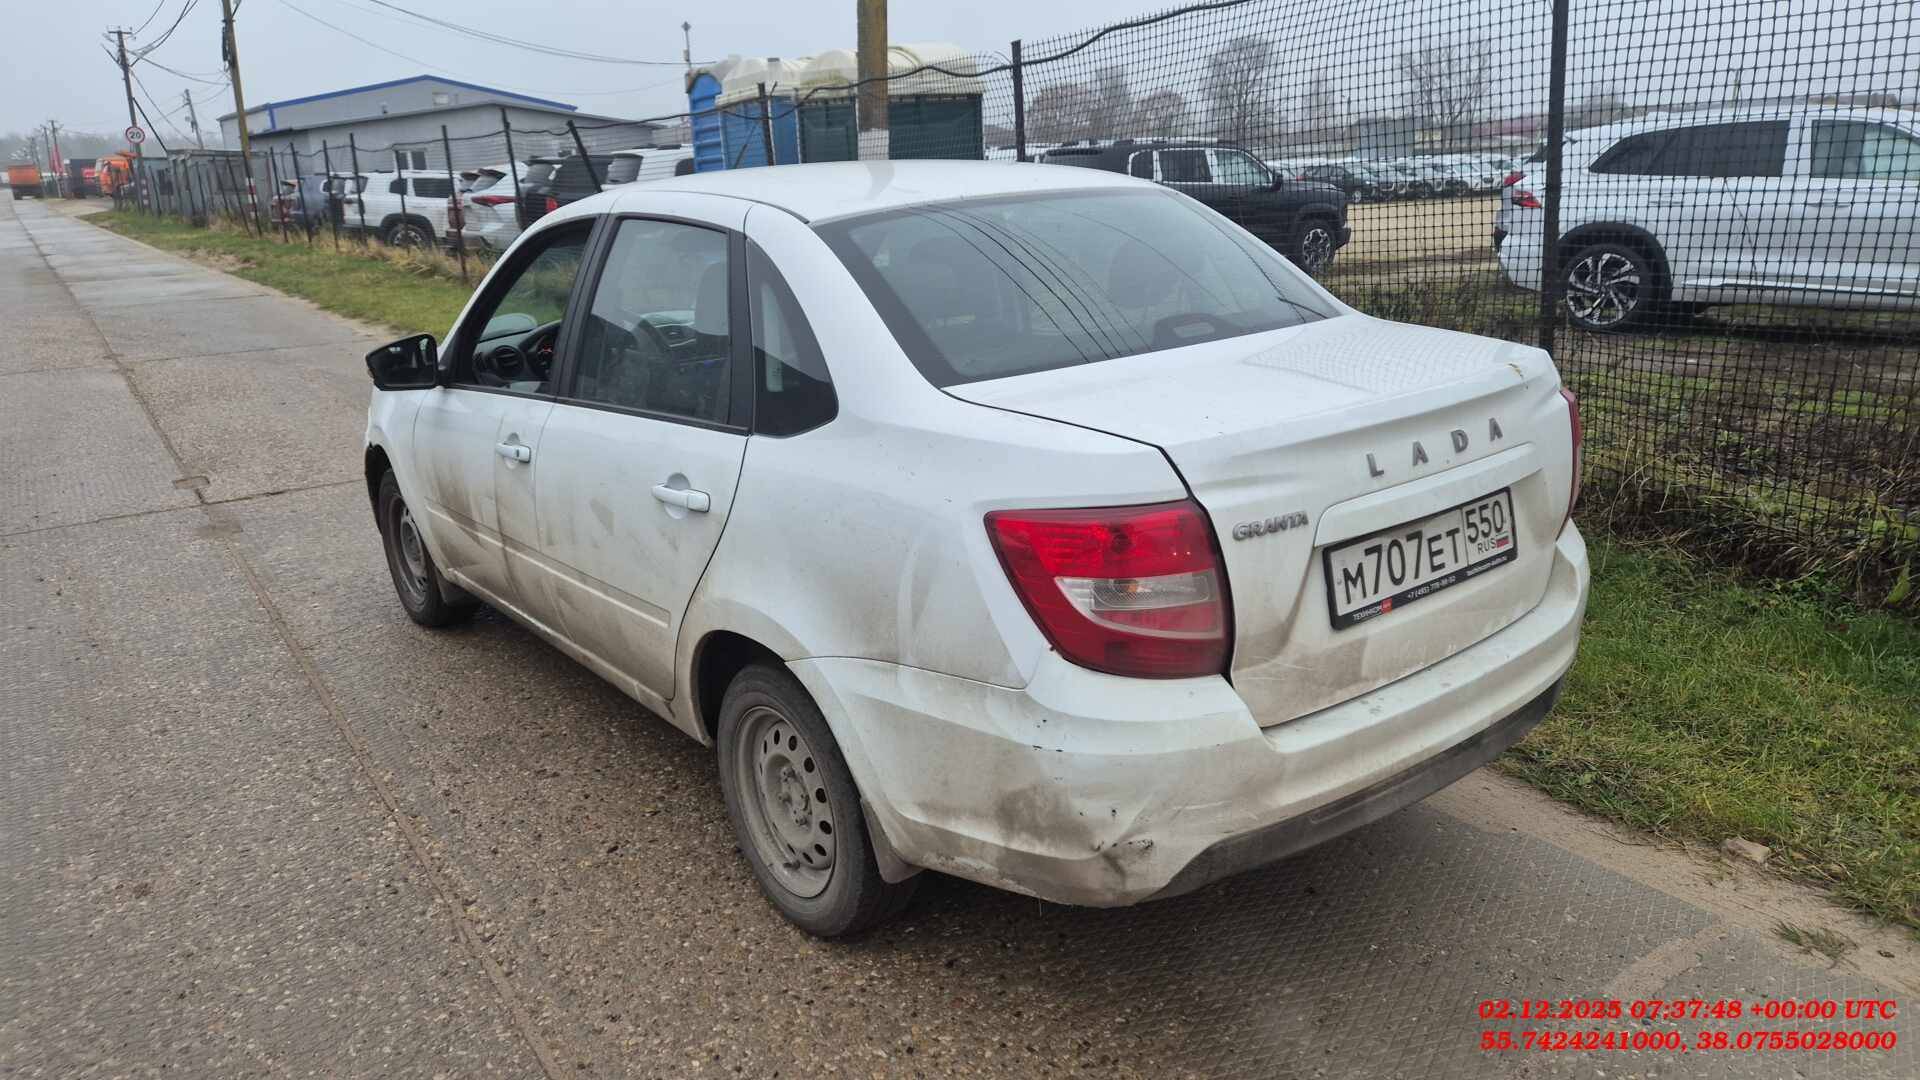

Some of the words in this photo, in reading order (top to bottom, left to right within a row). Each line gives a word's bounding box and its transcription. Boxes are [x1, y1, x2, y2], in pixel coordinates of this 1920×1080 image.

[129, 131, 141, 140] 20
[1366, 417, 1504, 478] LADA
[1232, 510, 1309, 541] GRANTA
[1465, 500, 1505, 544] 550
[1477, 537, 1497, 554] RUS
